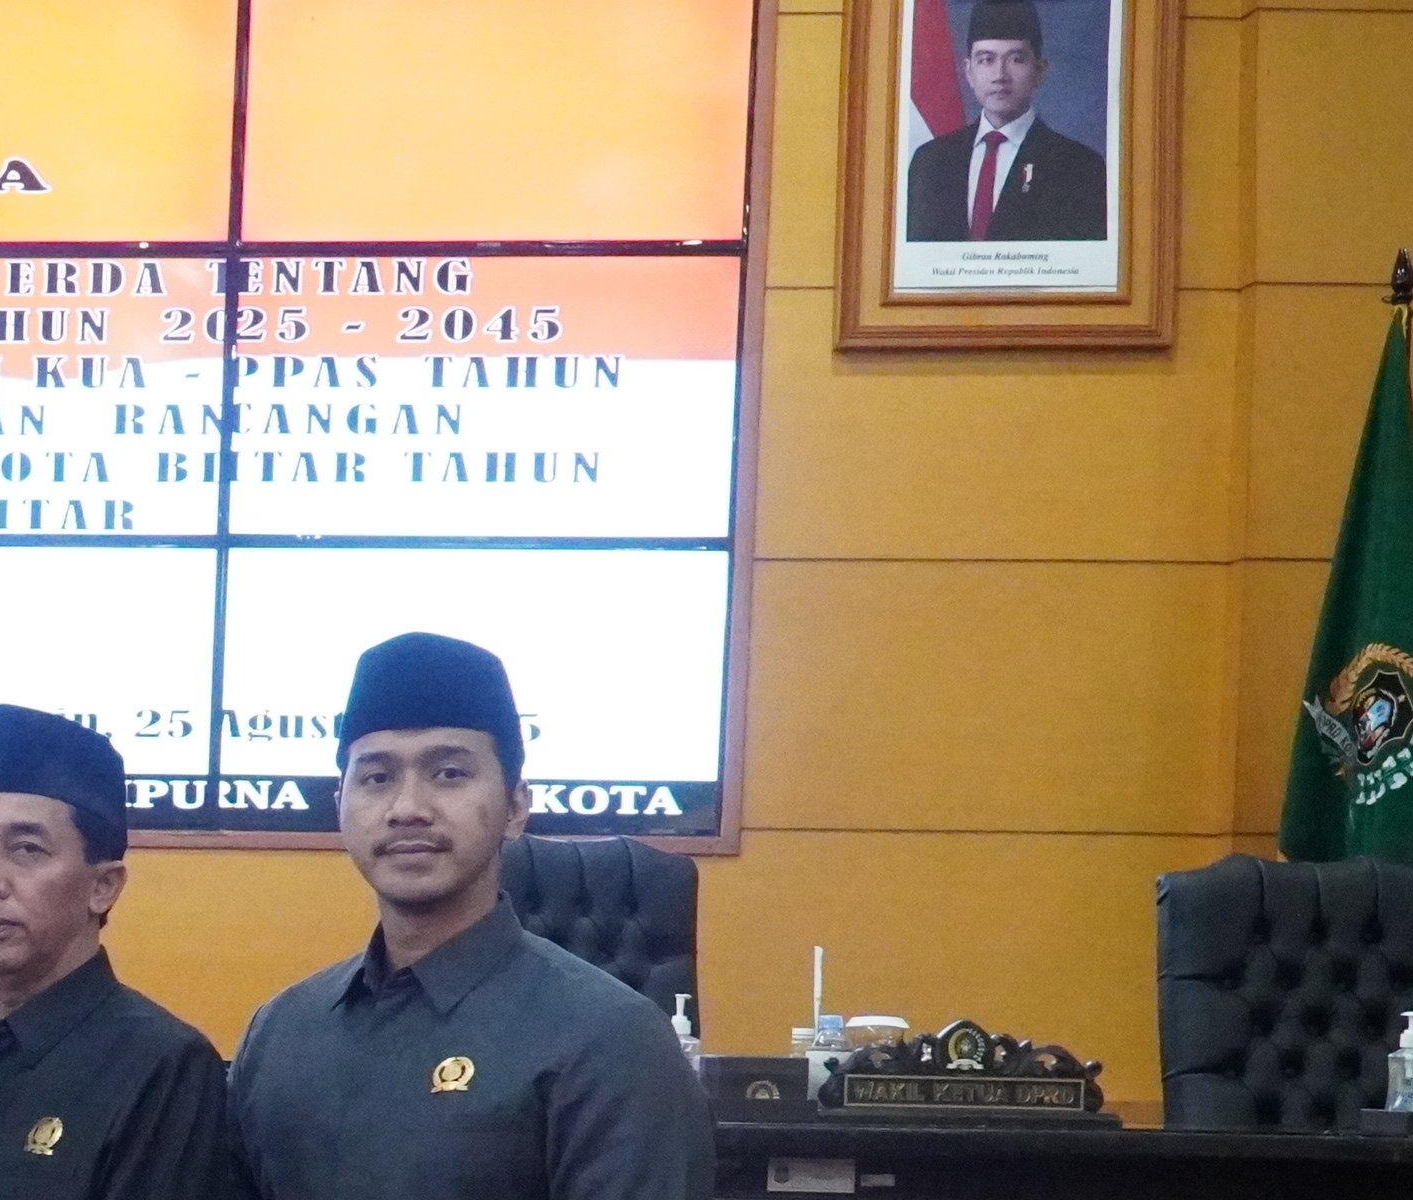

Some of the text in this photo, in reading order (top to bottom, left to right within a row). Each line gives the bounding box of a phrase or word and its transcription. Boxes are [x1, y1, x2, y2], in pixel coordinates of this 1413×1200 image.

[210, 260, 473, 294] TENTANG
[162, 308, 308, 342] 2025
[399, 308, 564, 342] 2045
[35, 356, 147, 388] KUA
[234, 356, 379, 388] PPAS
[424, 356, 623, 388] TAHUN
[113, 403, 463, 435] RANCANGAN
[403, 451, 601, 483] TAHUN
[134, 708, 194, 739] 25
[221, 708, 345, 743] Agust
[124, 779, 310, 811] IPURNA
[528, 784, 684, 816] KOTA
